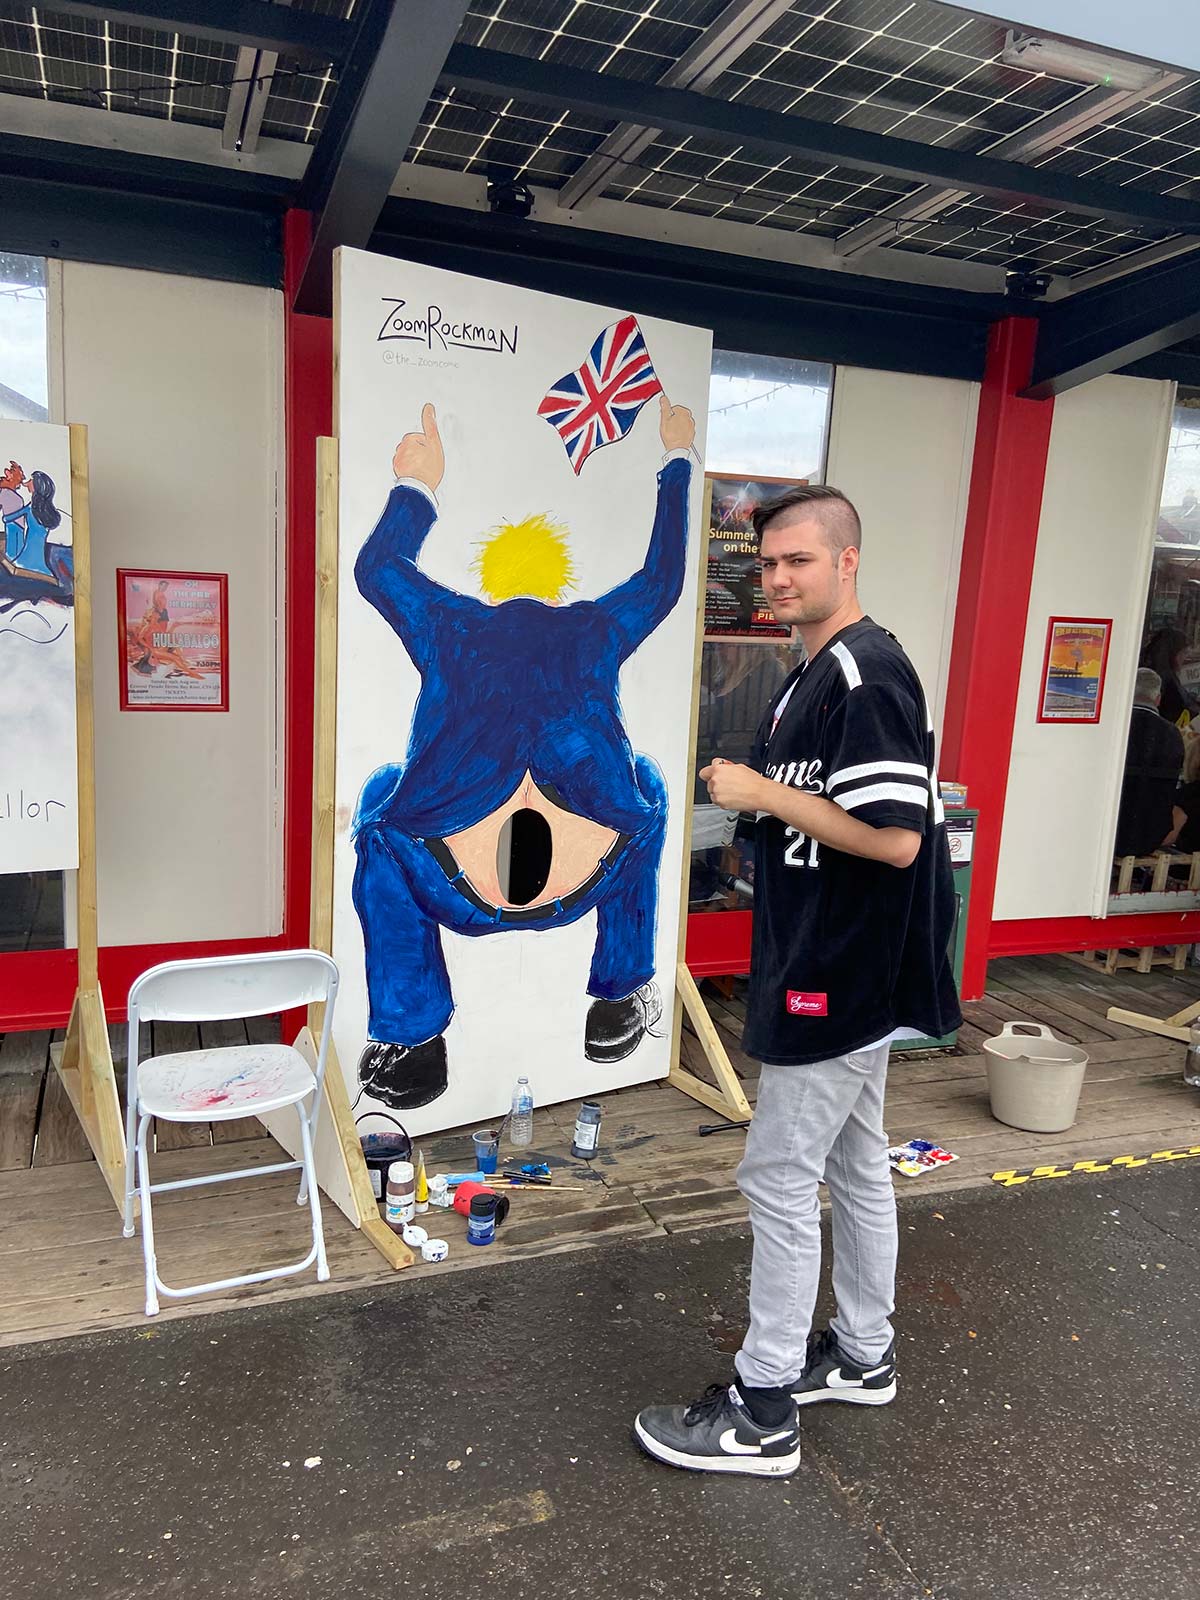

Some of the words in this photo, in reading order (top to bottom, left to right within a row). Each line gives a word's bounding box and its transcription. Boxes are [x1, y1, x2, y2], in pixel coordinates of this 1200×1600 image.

[709, 528, 755, 541] Summer
[723, 544, 737, 552] on
[740, 542, 758, 553] the
[757, 613, 775, 621] PIE
[153, 633, 219, 648] HULLABALOO
